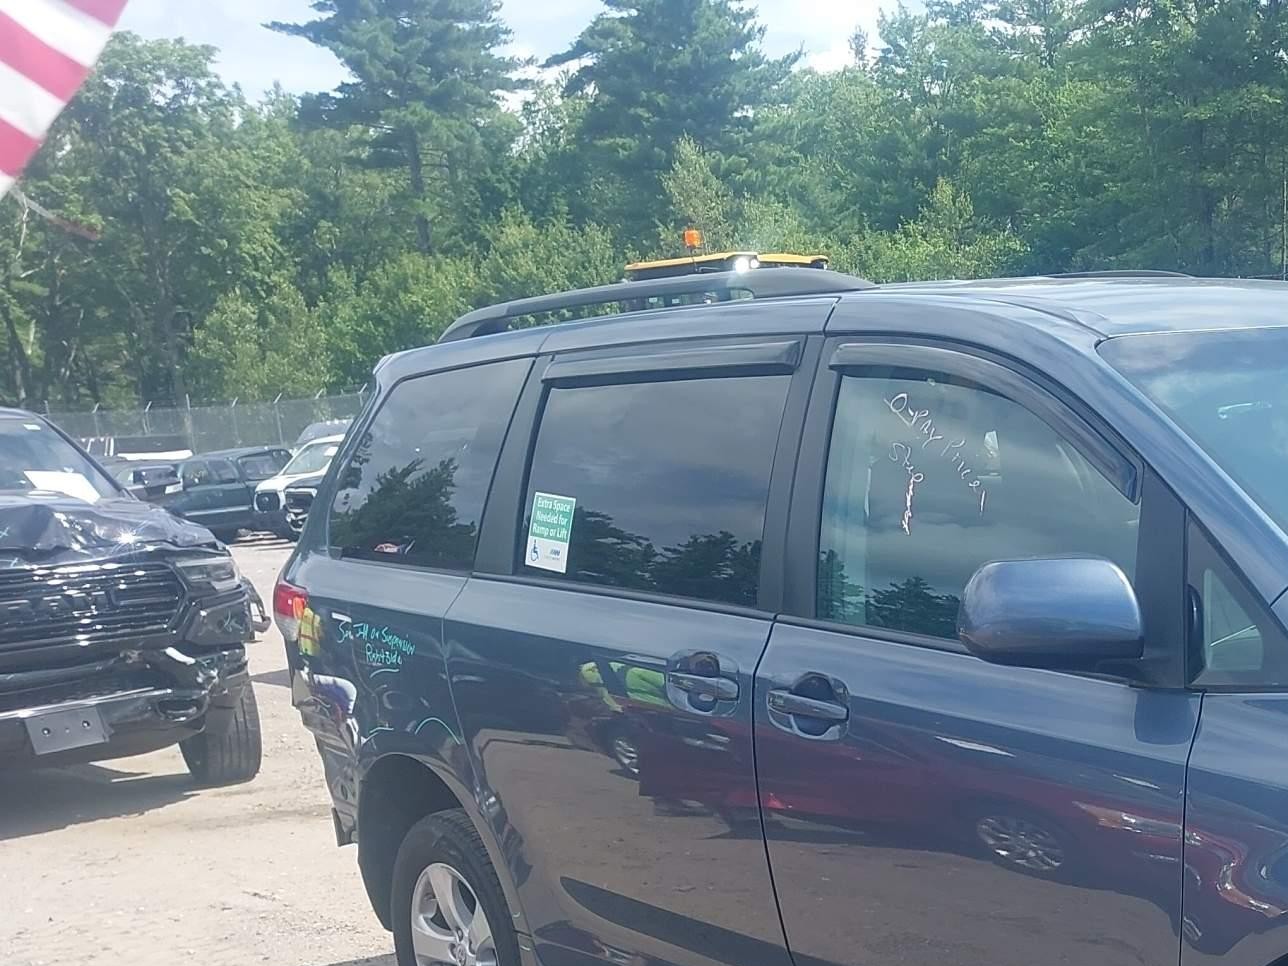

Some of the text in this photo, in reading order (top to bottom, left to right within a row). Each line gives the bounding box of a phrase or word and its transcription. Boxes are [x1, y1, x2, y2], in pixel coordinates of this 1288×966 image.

[537, 497, 571, 513] Extra Space
[536, 511, 568, 526] Needed for
[532, 523, 549, 537] Ramp
[556, 527, 568, 540] Lift
